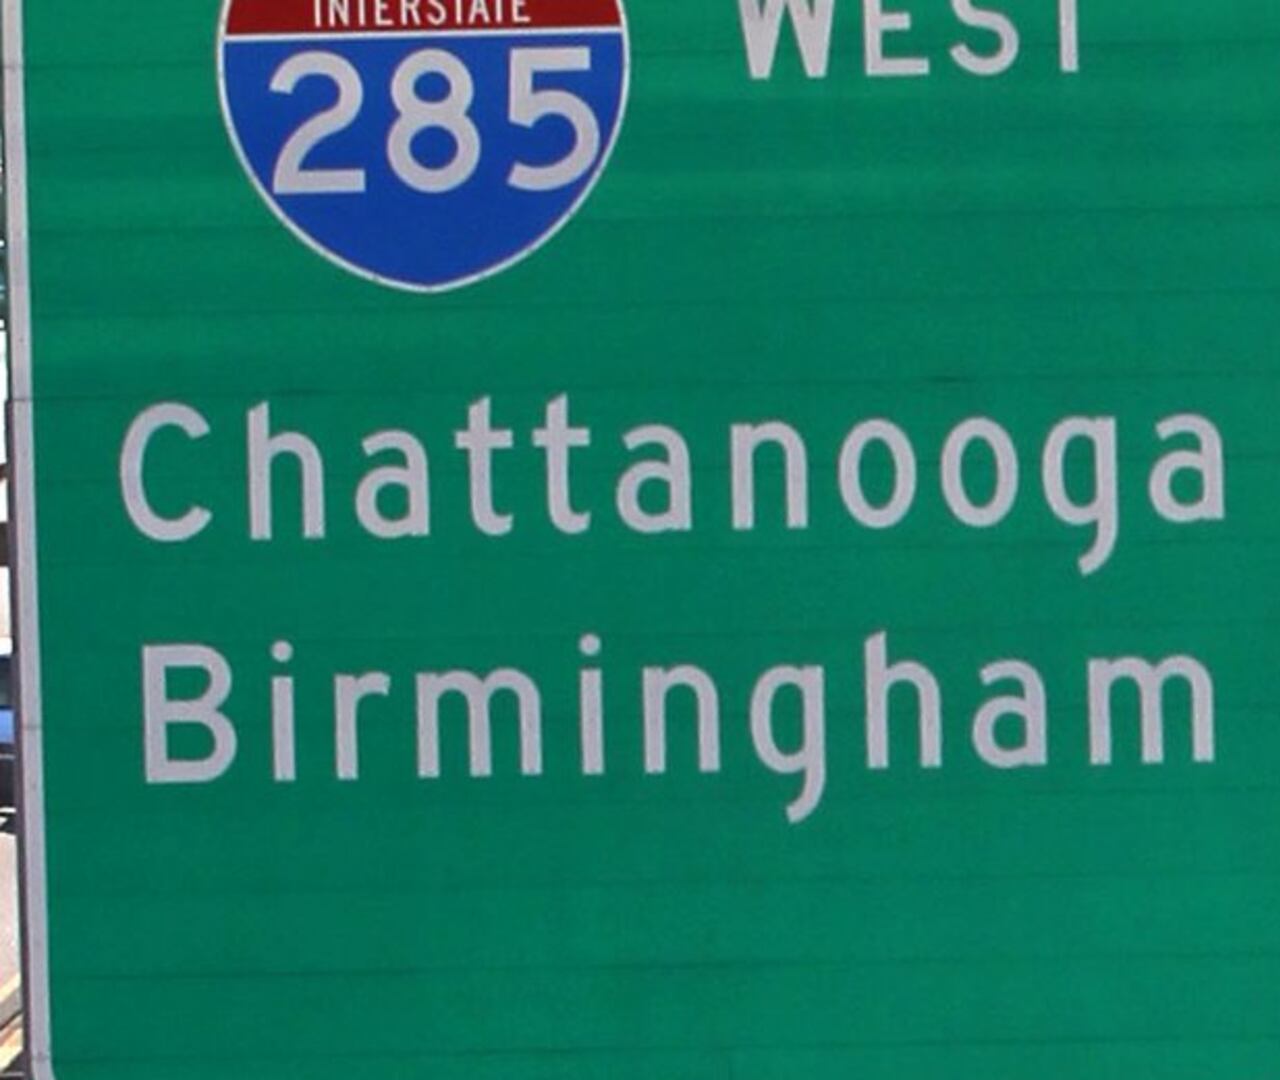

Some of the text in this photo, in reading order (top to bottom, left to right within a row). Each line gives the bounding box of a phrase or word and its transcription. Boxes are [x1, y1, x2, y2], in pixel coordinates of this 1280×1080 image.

[313, 0, 530, 27] INTERSTATE
[738, 0, 1079, 79] WEST
[270, 47, 599, 194] 285
[118, 394, 1226, 575] Chattanooga
[141, 630, 1216, 822] Birmingham
